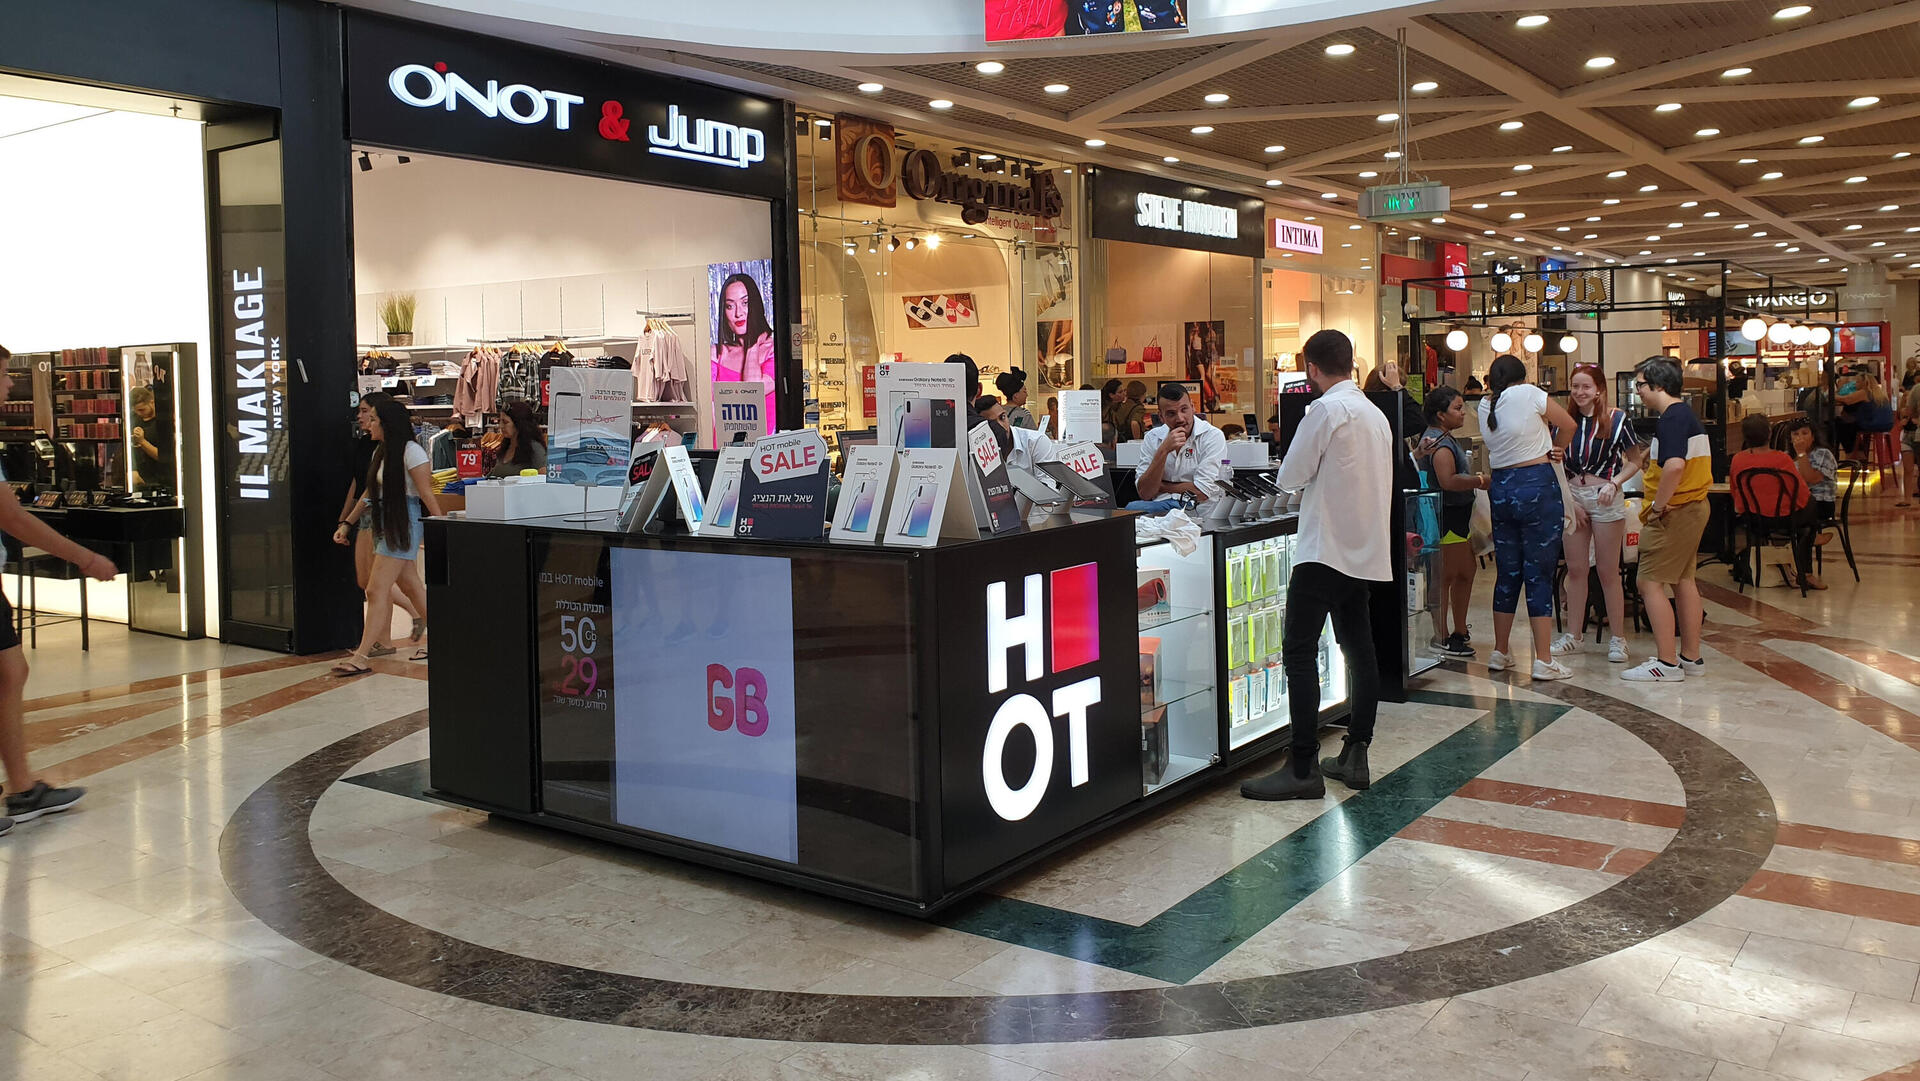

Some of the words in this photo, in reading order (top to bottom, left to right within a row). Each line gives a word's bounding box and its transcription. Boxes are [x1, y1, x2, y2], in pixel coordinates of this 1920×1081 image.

[598, 99, 630, 142] &
[648, 104, 765, 169] Jump
[986, 216, 1011, 229] ntelligent
[1014, 218, 1032, 233] Quality
[1136, 192, 1182, 231] STEVE
[1183, 200, 1238, 239] MADDEN
[1281, 225, 1318, 248] INTIMA
[1747, 291, 1827, 308] MANGO
[233, 266, 270, 454] MAKIAGE
[271, 336, 281, 383] YORK
[273, 387, 283, 429] NEW
[722, 403, 758, 421] תודה
[461, 453, 476, 465] 79
[760, 443, 775, 453] HOT
[777, 439, 801, 450] mobile
[978, 438, 998, 468] SALE
[760, 445, 817, 475] SALE
[240, 465, 270, 499] IL
[751, 494, 776, 503] הנציג
[777, 494, 792, 502] את
[793, 493, 814, 502] שאל
[555, 573, 572, 585] HOT
[574, 575, 604, 588] mobile
[561, 654, 598, 696] 29
[706, 662, 770, 738] GB
